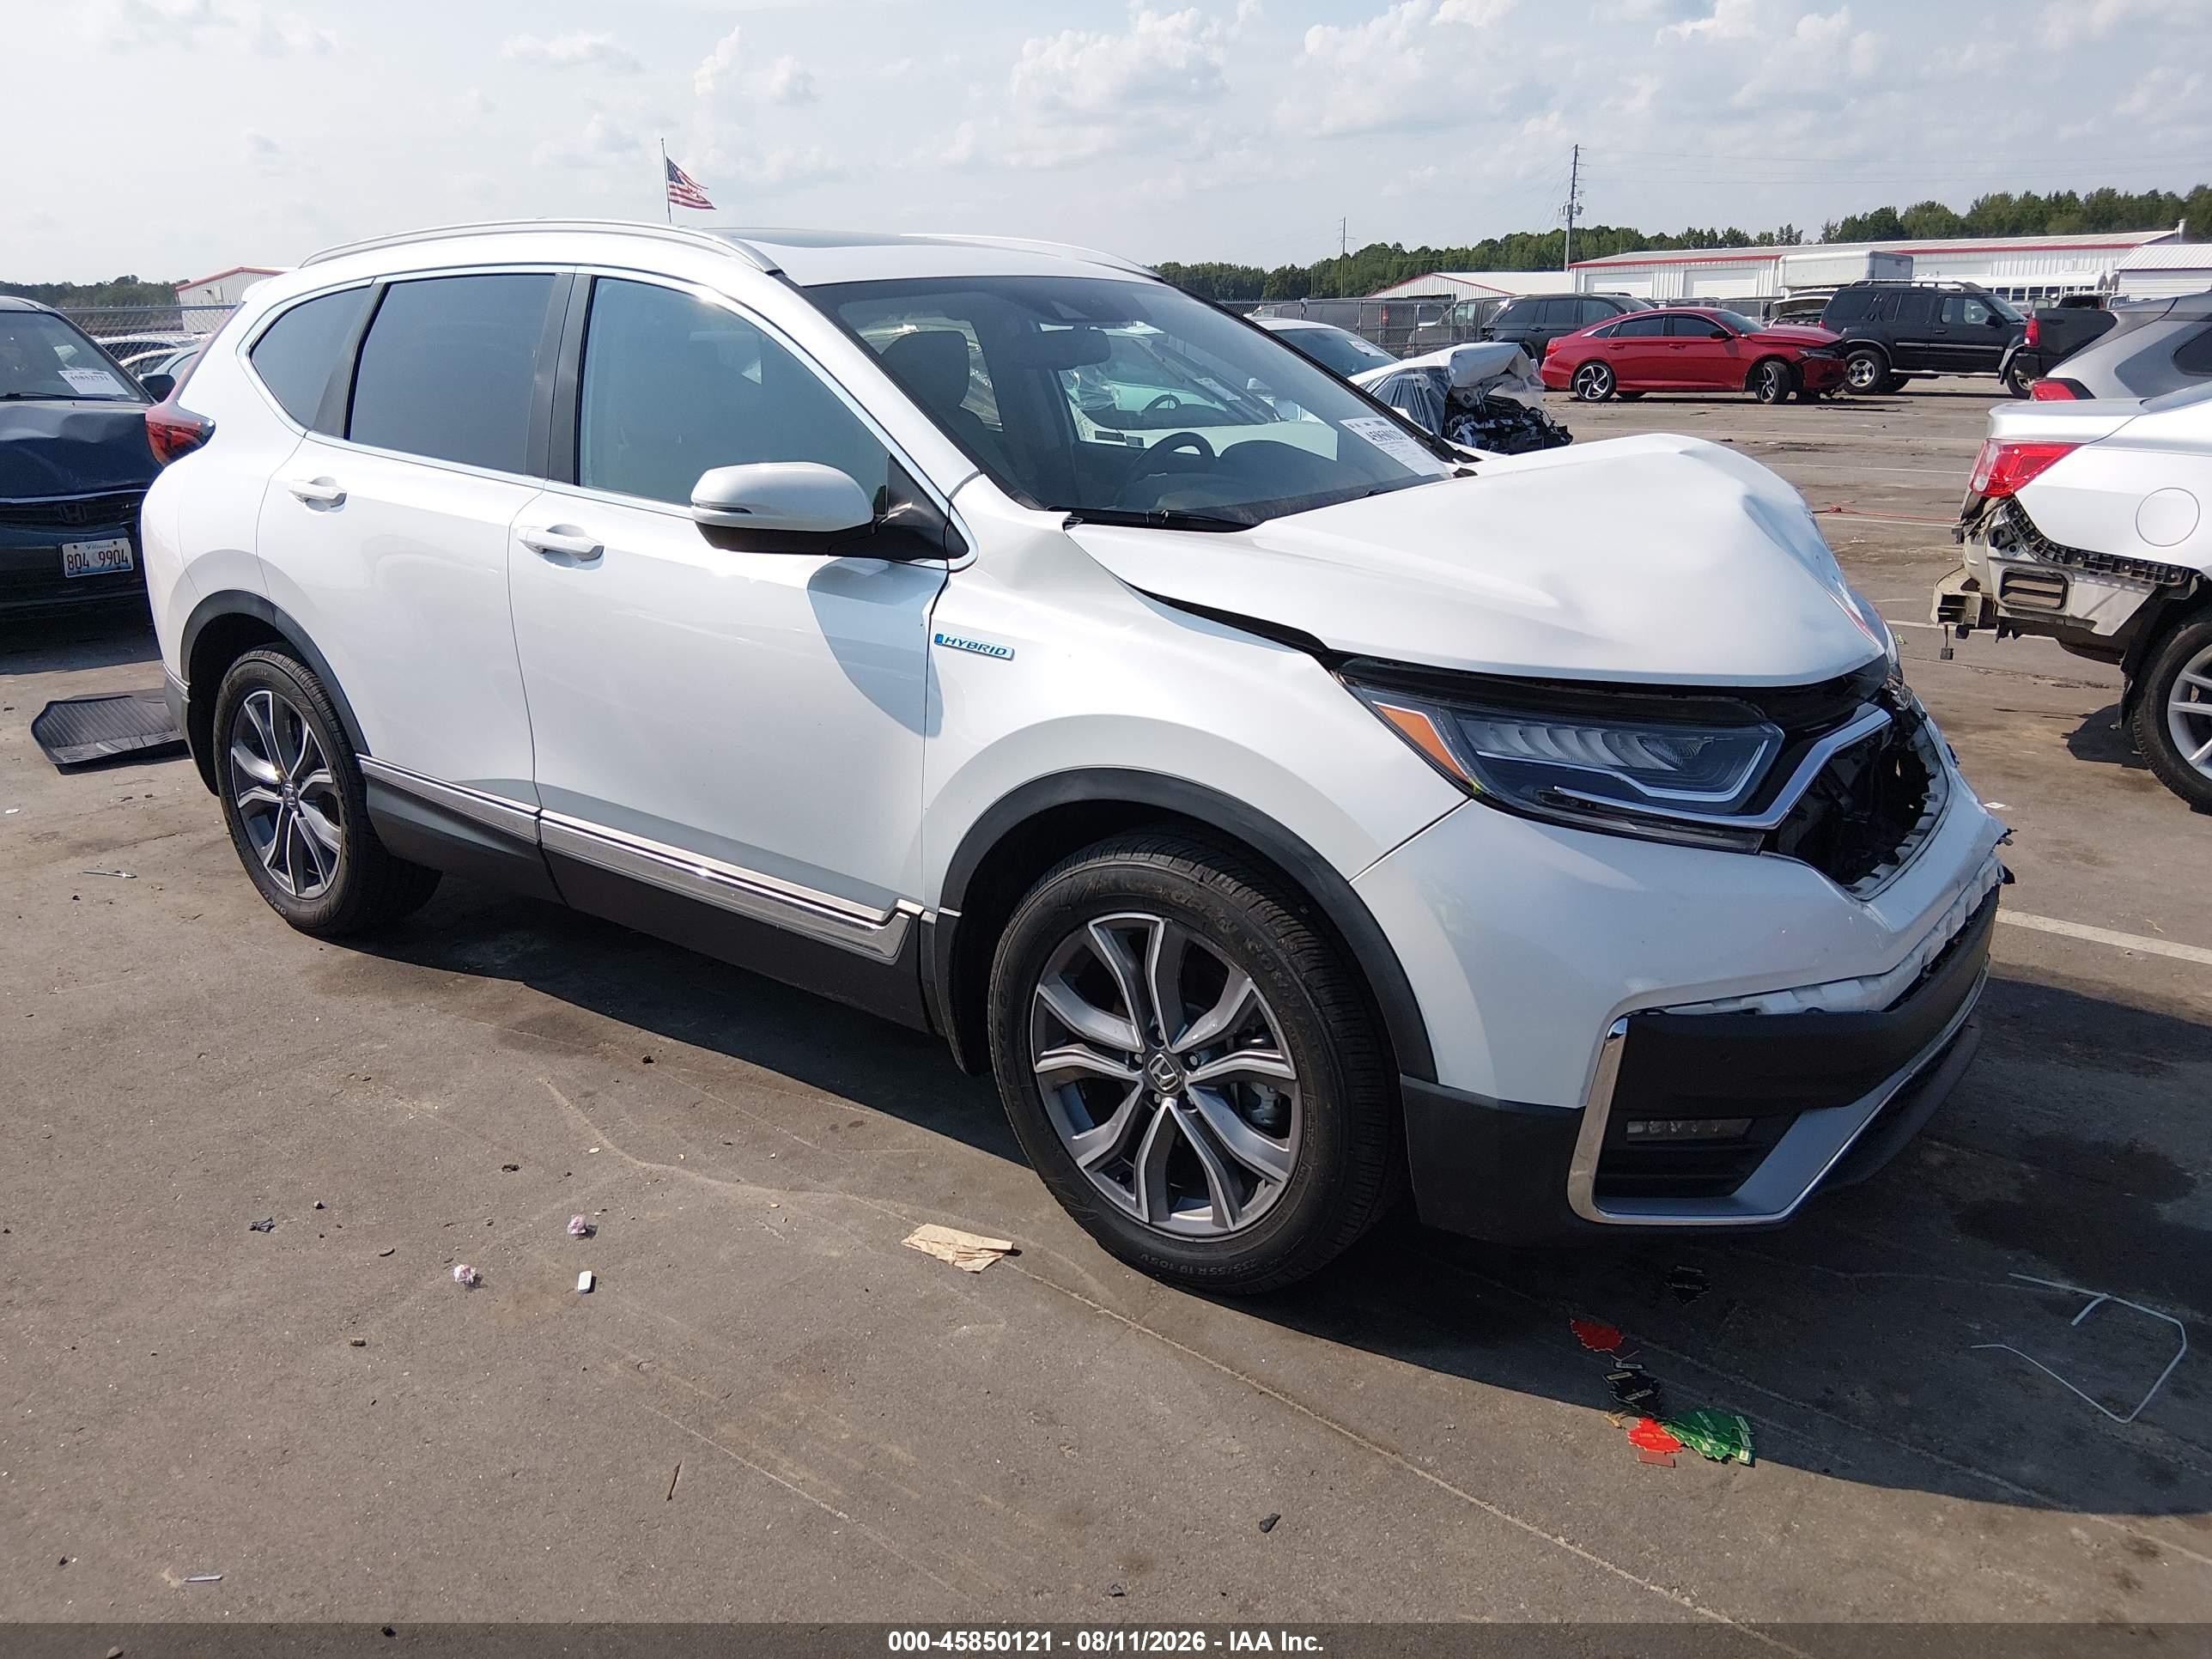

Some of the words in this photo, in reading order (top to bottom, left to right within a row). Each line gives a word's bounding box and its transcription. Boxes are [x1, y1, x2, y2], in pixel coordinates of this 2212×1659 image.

[66, 552, 90, 570] 804
[98, 549, 129, 568] 9904
[944, 636, 1007, 656] HYBRID
